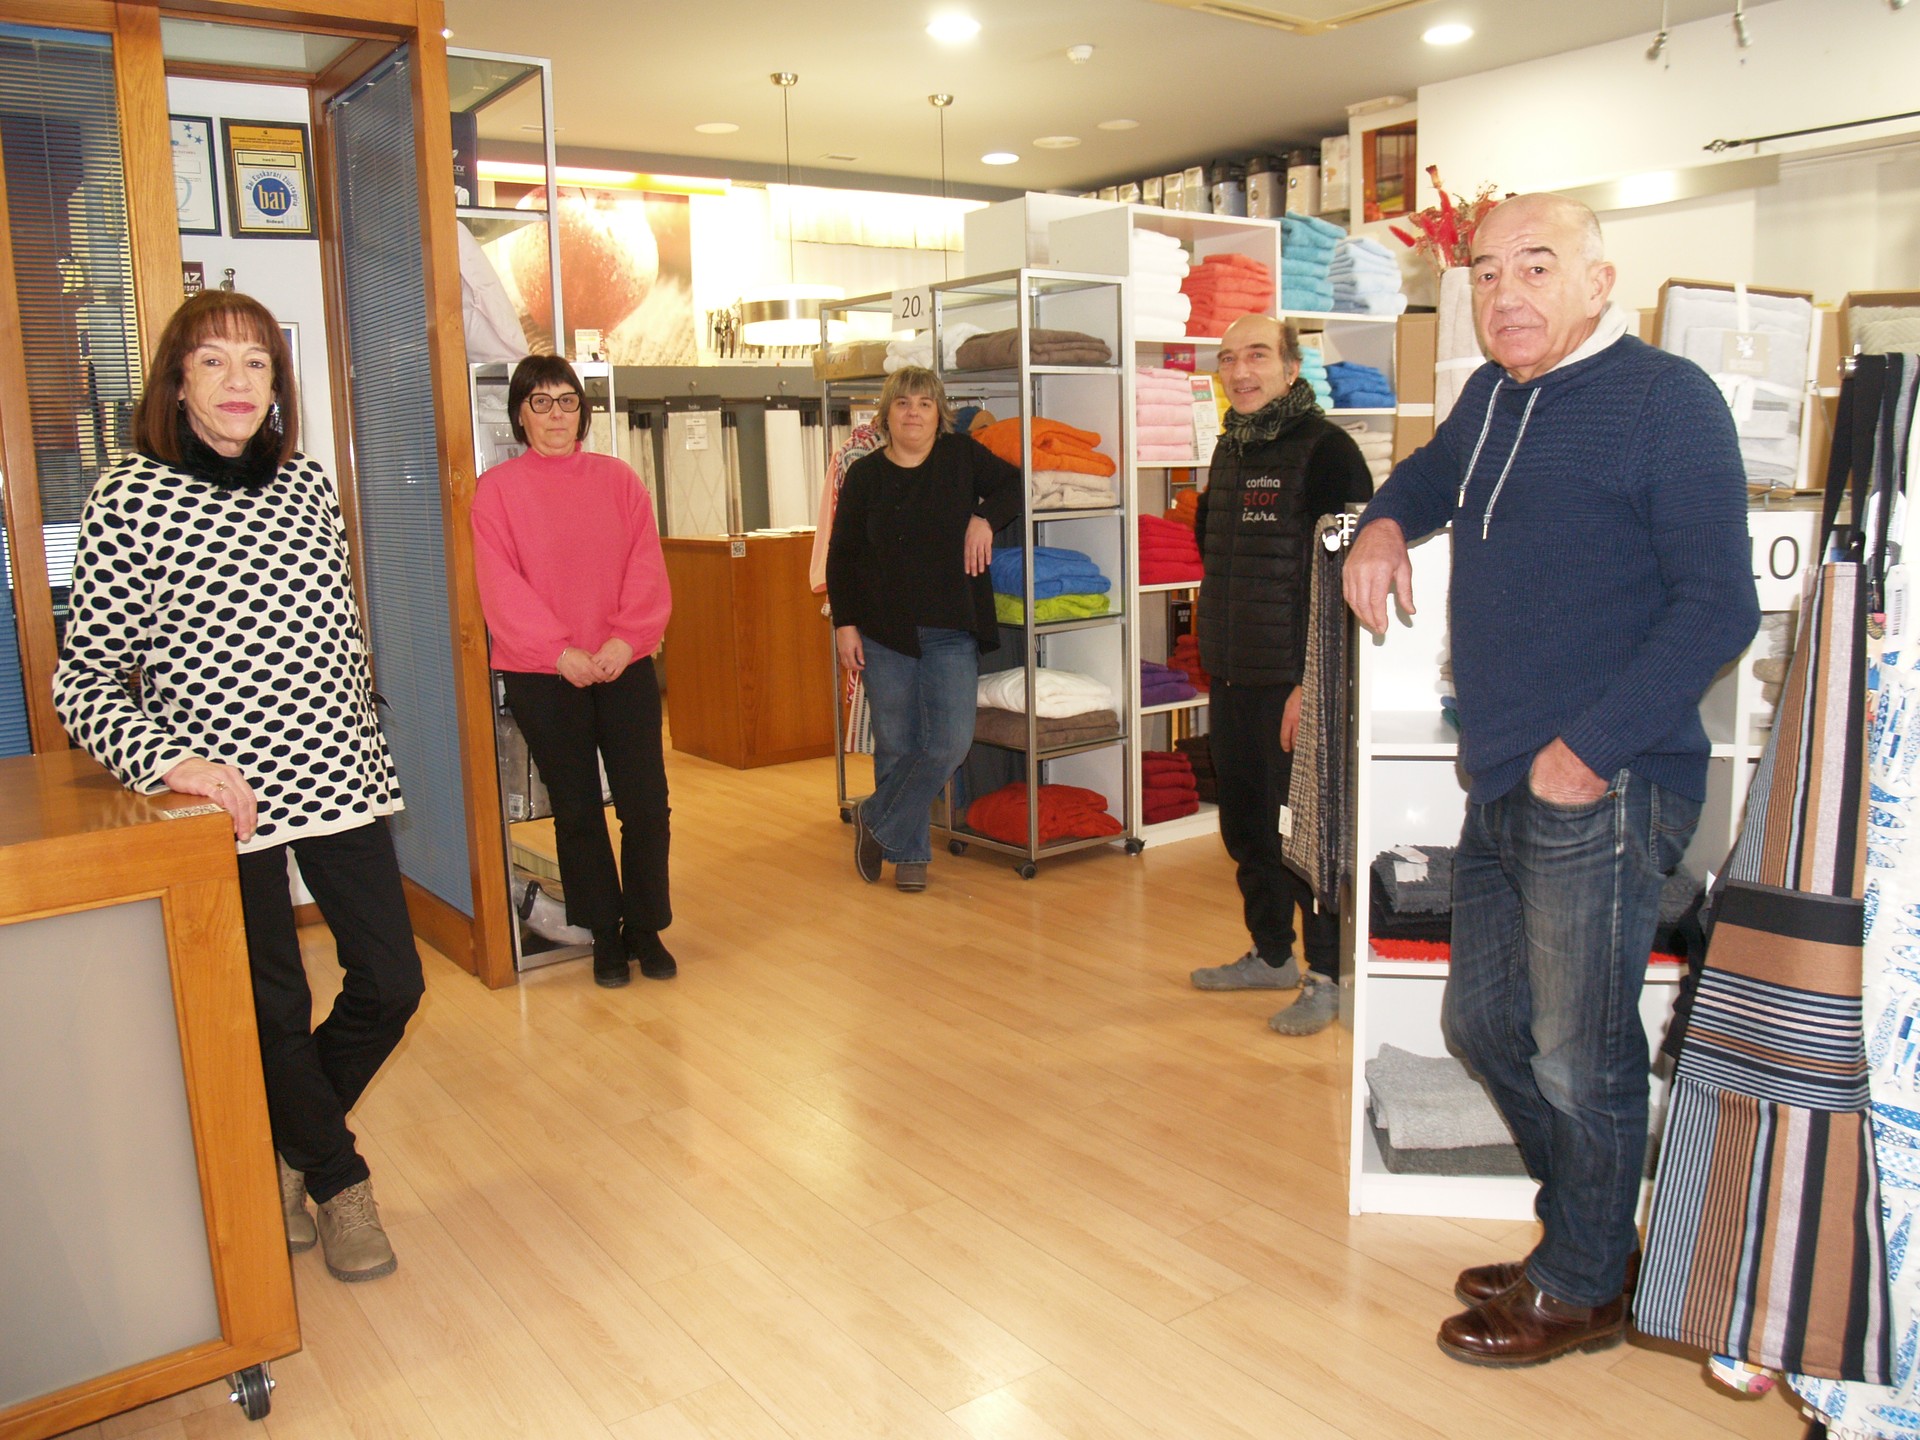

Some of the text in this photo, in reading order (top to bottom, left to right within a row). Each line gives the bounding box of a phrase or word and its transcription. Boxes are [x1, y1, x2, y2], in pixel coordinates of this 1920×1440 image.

[257, 184, 287, 210] bai
[902, 295, 921, 319] 20
[1246, 475, 1281, 488] cortina
[1243, 490, 1279, 506] stor
[1242, 507, 1277, 522] izara
